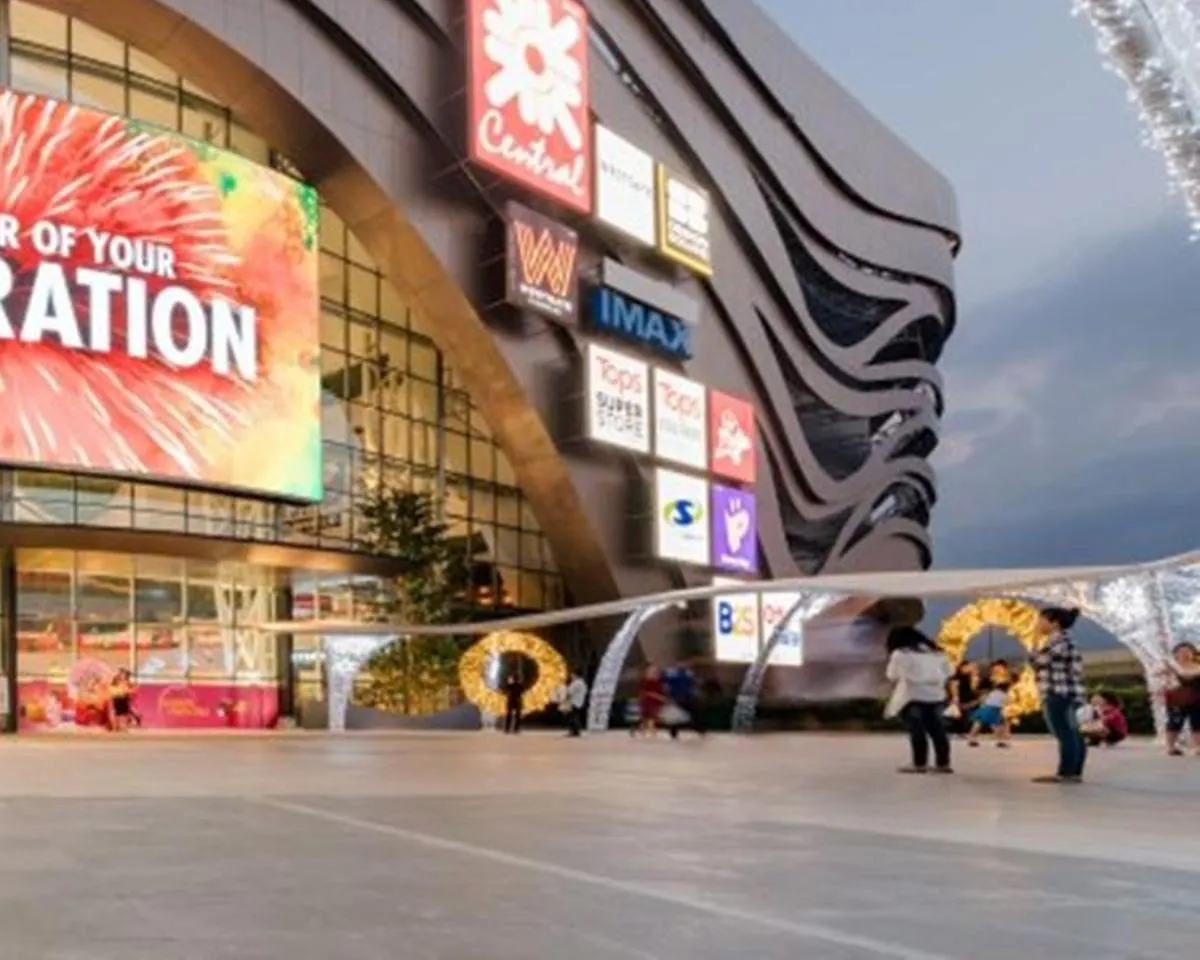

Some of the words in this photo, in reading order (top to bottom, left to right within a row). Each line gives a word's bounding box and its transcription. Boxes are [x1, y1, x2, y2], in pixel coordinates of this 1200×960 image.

[477, 108, 585, 197] Central
[32, 220, 79, 258] OF
[85, 227, 178, 280] YOUR
[601, 289, 687, 351] IMAX
[596, 355, 642, 394] Tops
[596, 391, 643, 419] SUPER
[718, 600, 756, 637] B2S
